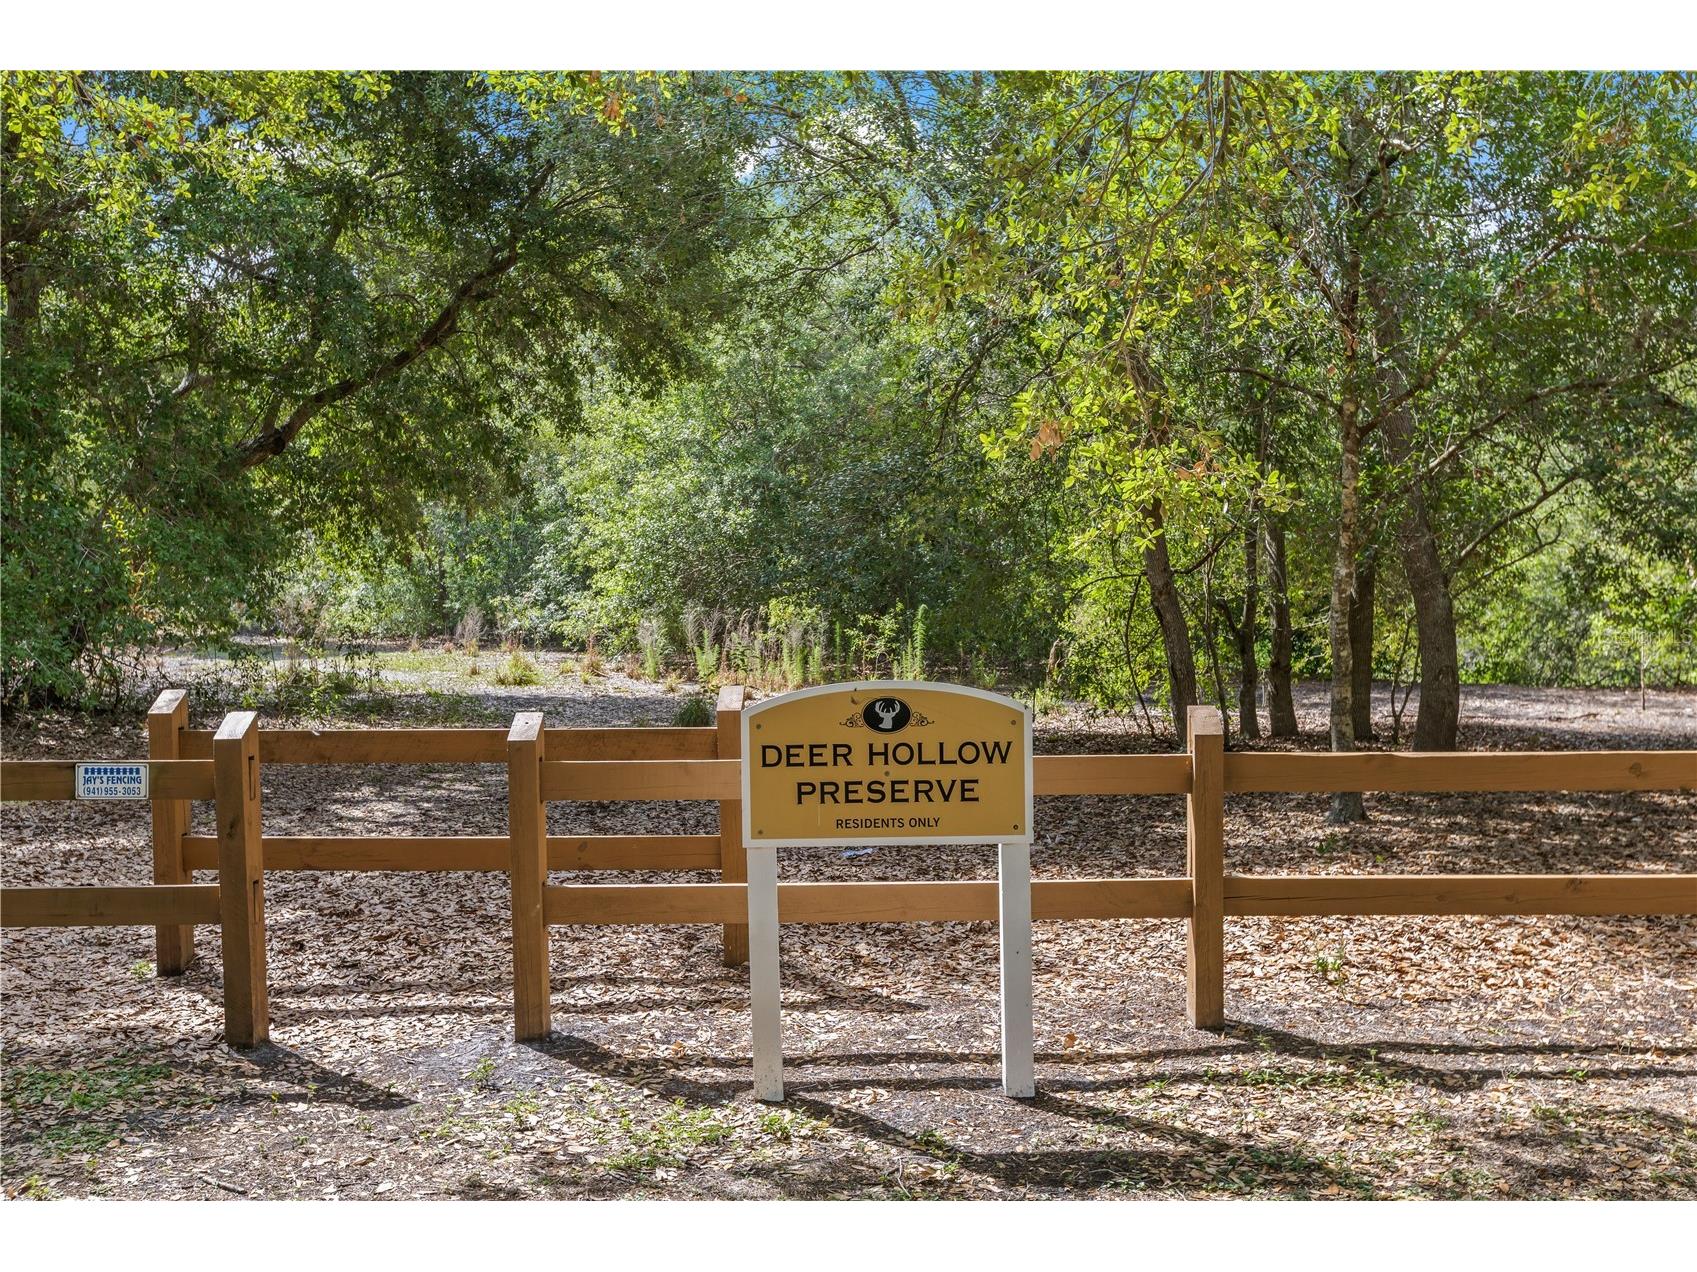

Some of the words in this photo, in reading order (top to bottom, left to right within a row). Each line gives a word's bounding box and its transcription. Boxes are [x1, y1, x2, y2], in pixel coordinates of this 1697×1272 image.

[760, 743, 853, 768] DEER
[868, 741, 1013, 766] HOLLOW
[83, 776, 104, 785] JAY'S
[106, 776, 142, 785] FENCING
[83, 786, 103, 796] (941)
[796, 779, 980, 805] PRESERVE
[836, 818, 905, 829] RESIDENTS
[908, 817, 940, 828] ONLY
